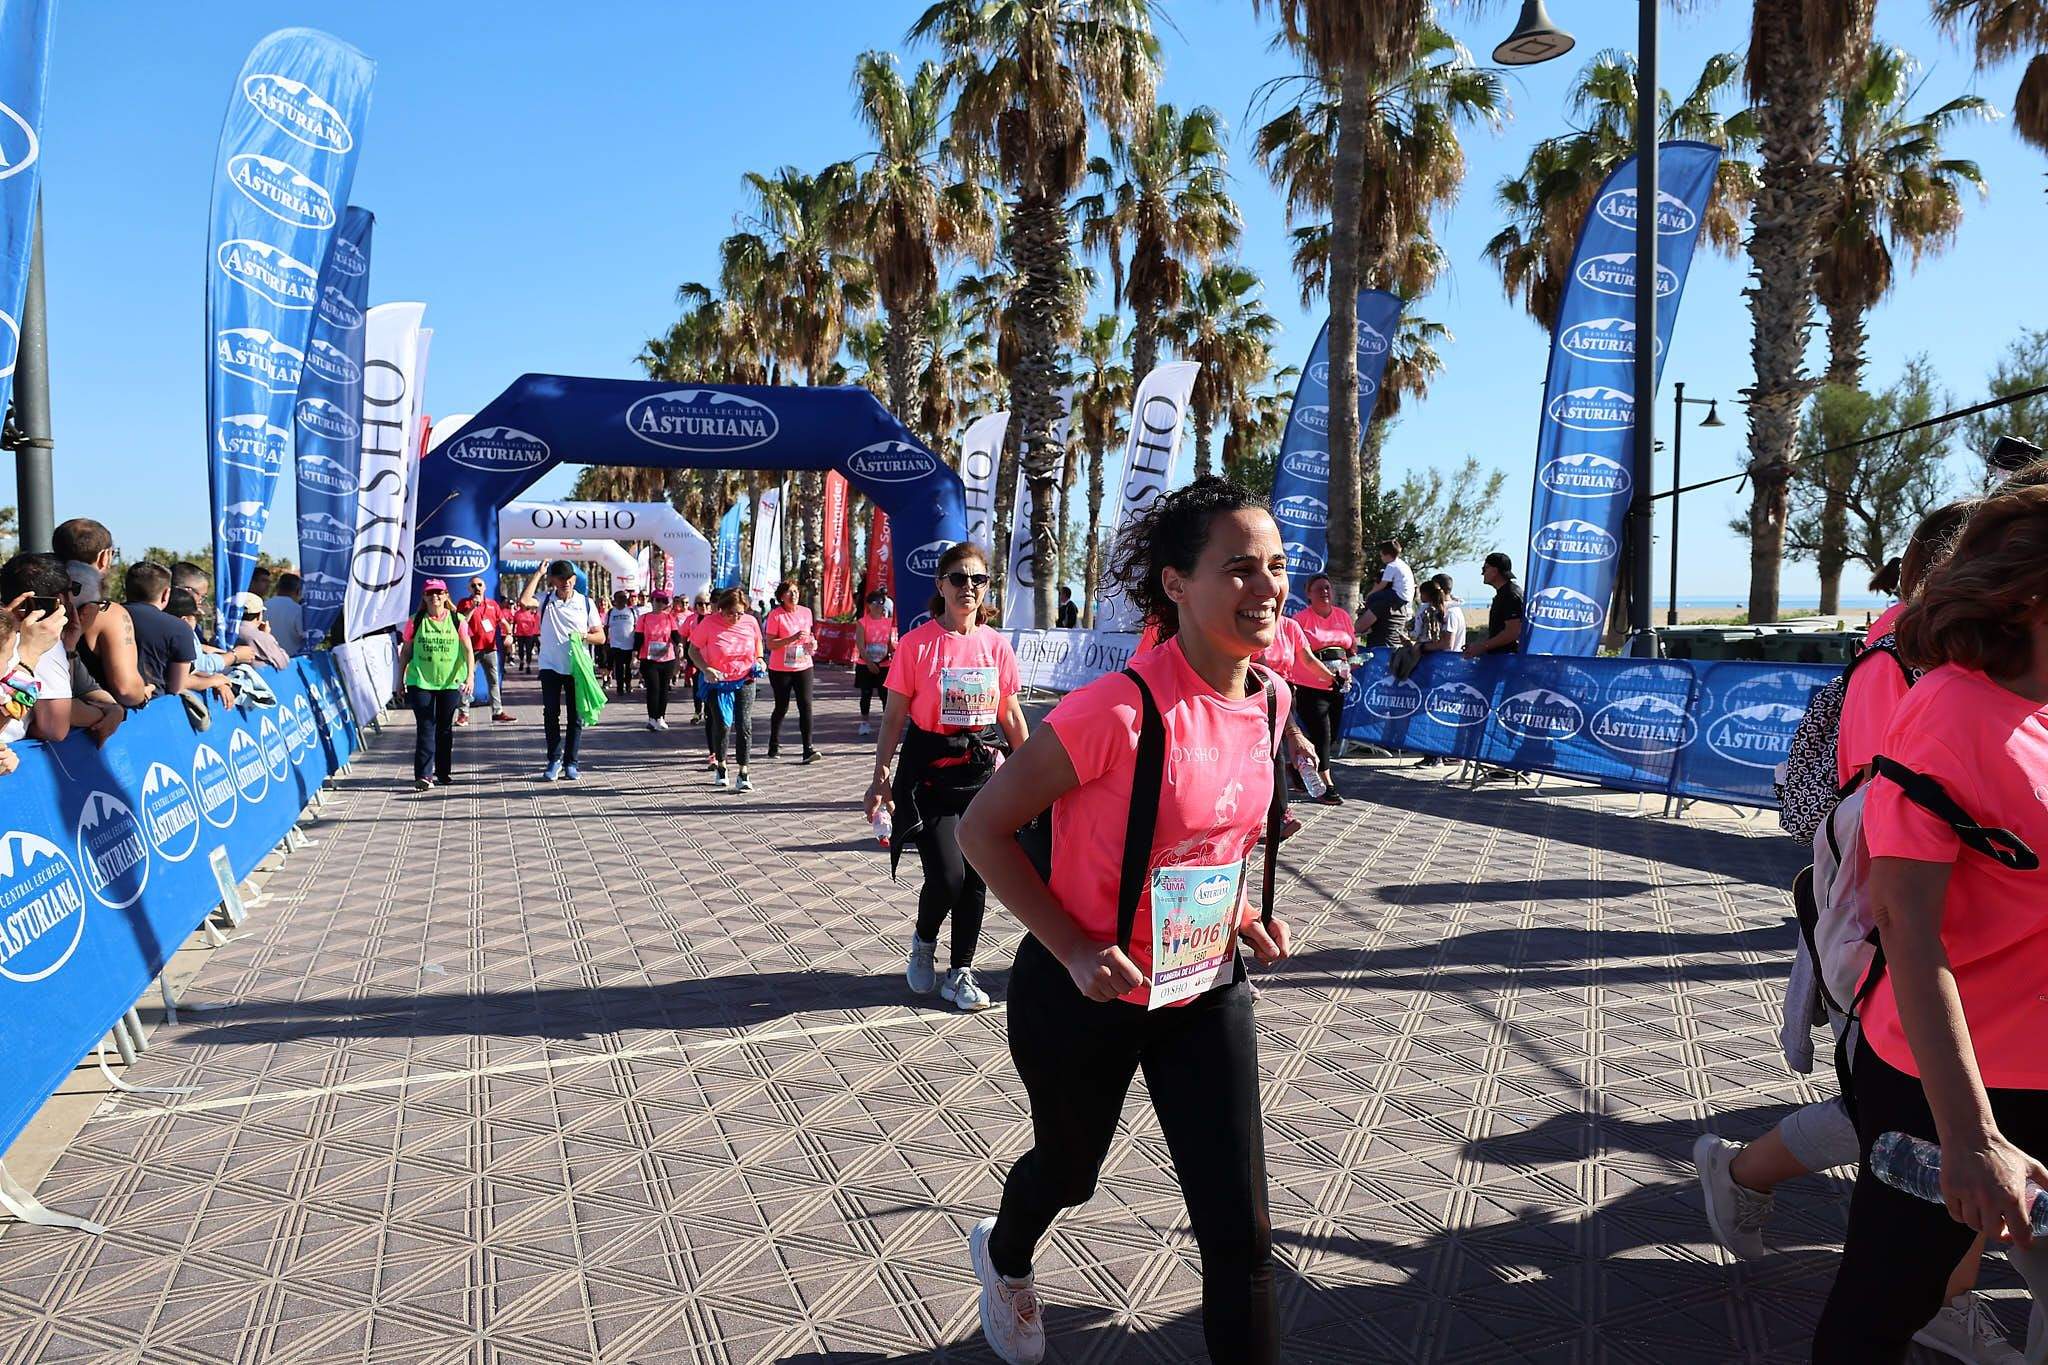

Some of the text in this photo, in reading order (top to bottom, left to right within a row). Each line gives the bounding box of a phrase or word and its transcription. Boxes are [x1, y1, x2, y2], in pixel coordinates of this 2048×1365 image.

[1603, 198, 1686, 229] ASTIANA
[1582, 263, 1669, 293] ASTURNA
[1566, 331, 1636, 354] ASTURIA
[299, 404, 354, 437] ASTURIANA
[638, 406, 768, 438] ASTURIANA
[661, 404, 763, 417] CENTRAL LECHERA
[454, 443, 543, 462] ASTURIANA
[856, 457, 932, 473] ASTURIANA
[352, 359, 406, 593] OYSHO
[1286, 456, 1330, 478] ASTURIA
[1545, 466, 1623, 490] ASTURIANA
[531, 508, 636, 530] OYSHO
[831, 480, 844, 547] Santander
[1537, 534, 1610, 556] ASTURIANA
[414, 551, 485, 568] ASTURIANA
[1529, 600, 1596, 624] ASTURIANA
[1021, 639, 1069, 665] OYSHO
[1084, 643, 1137, 672] OYSH
[963, 693, 986, 704] 016
[1367, 689, 1416, 709] ASTURIANA
[1501, 704, 1575, 732] ASTURIANA
[1596, 713, 1688, 743] ASTURIANA
[1714, 723, 1793, 753] ASTURI
[1171, 746, 1219, 763] OYSHO
[147, 798, 197, 847] ASTURIANA
[84, 832, 146, 893] ASTURIANA
[0, 860, 66, 909] CENTRAL LECHERA
[1161, 883, 1186, 891] SUMA
[0, 877, 82, 965] ASTURIANA
[1190, 922, 1222, 949] 016
[1160, 981, 1188, 999] OYSHO
